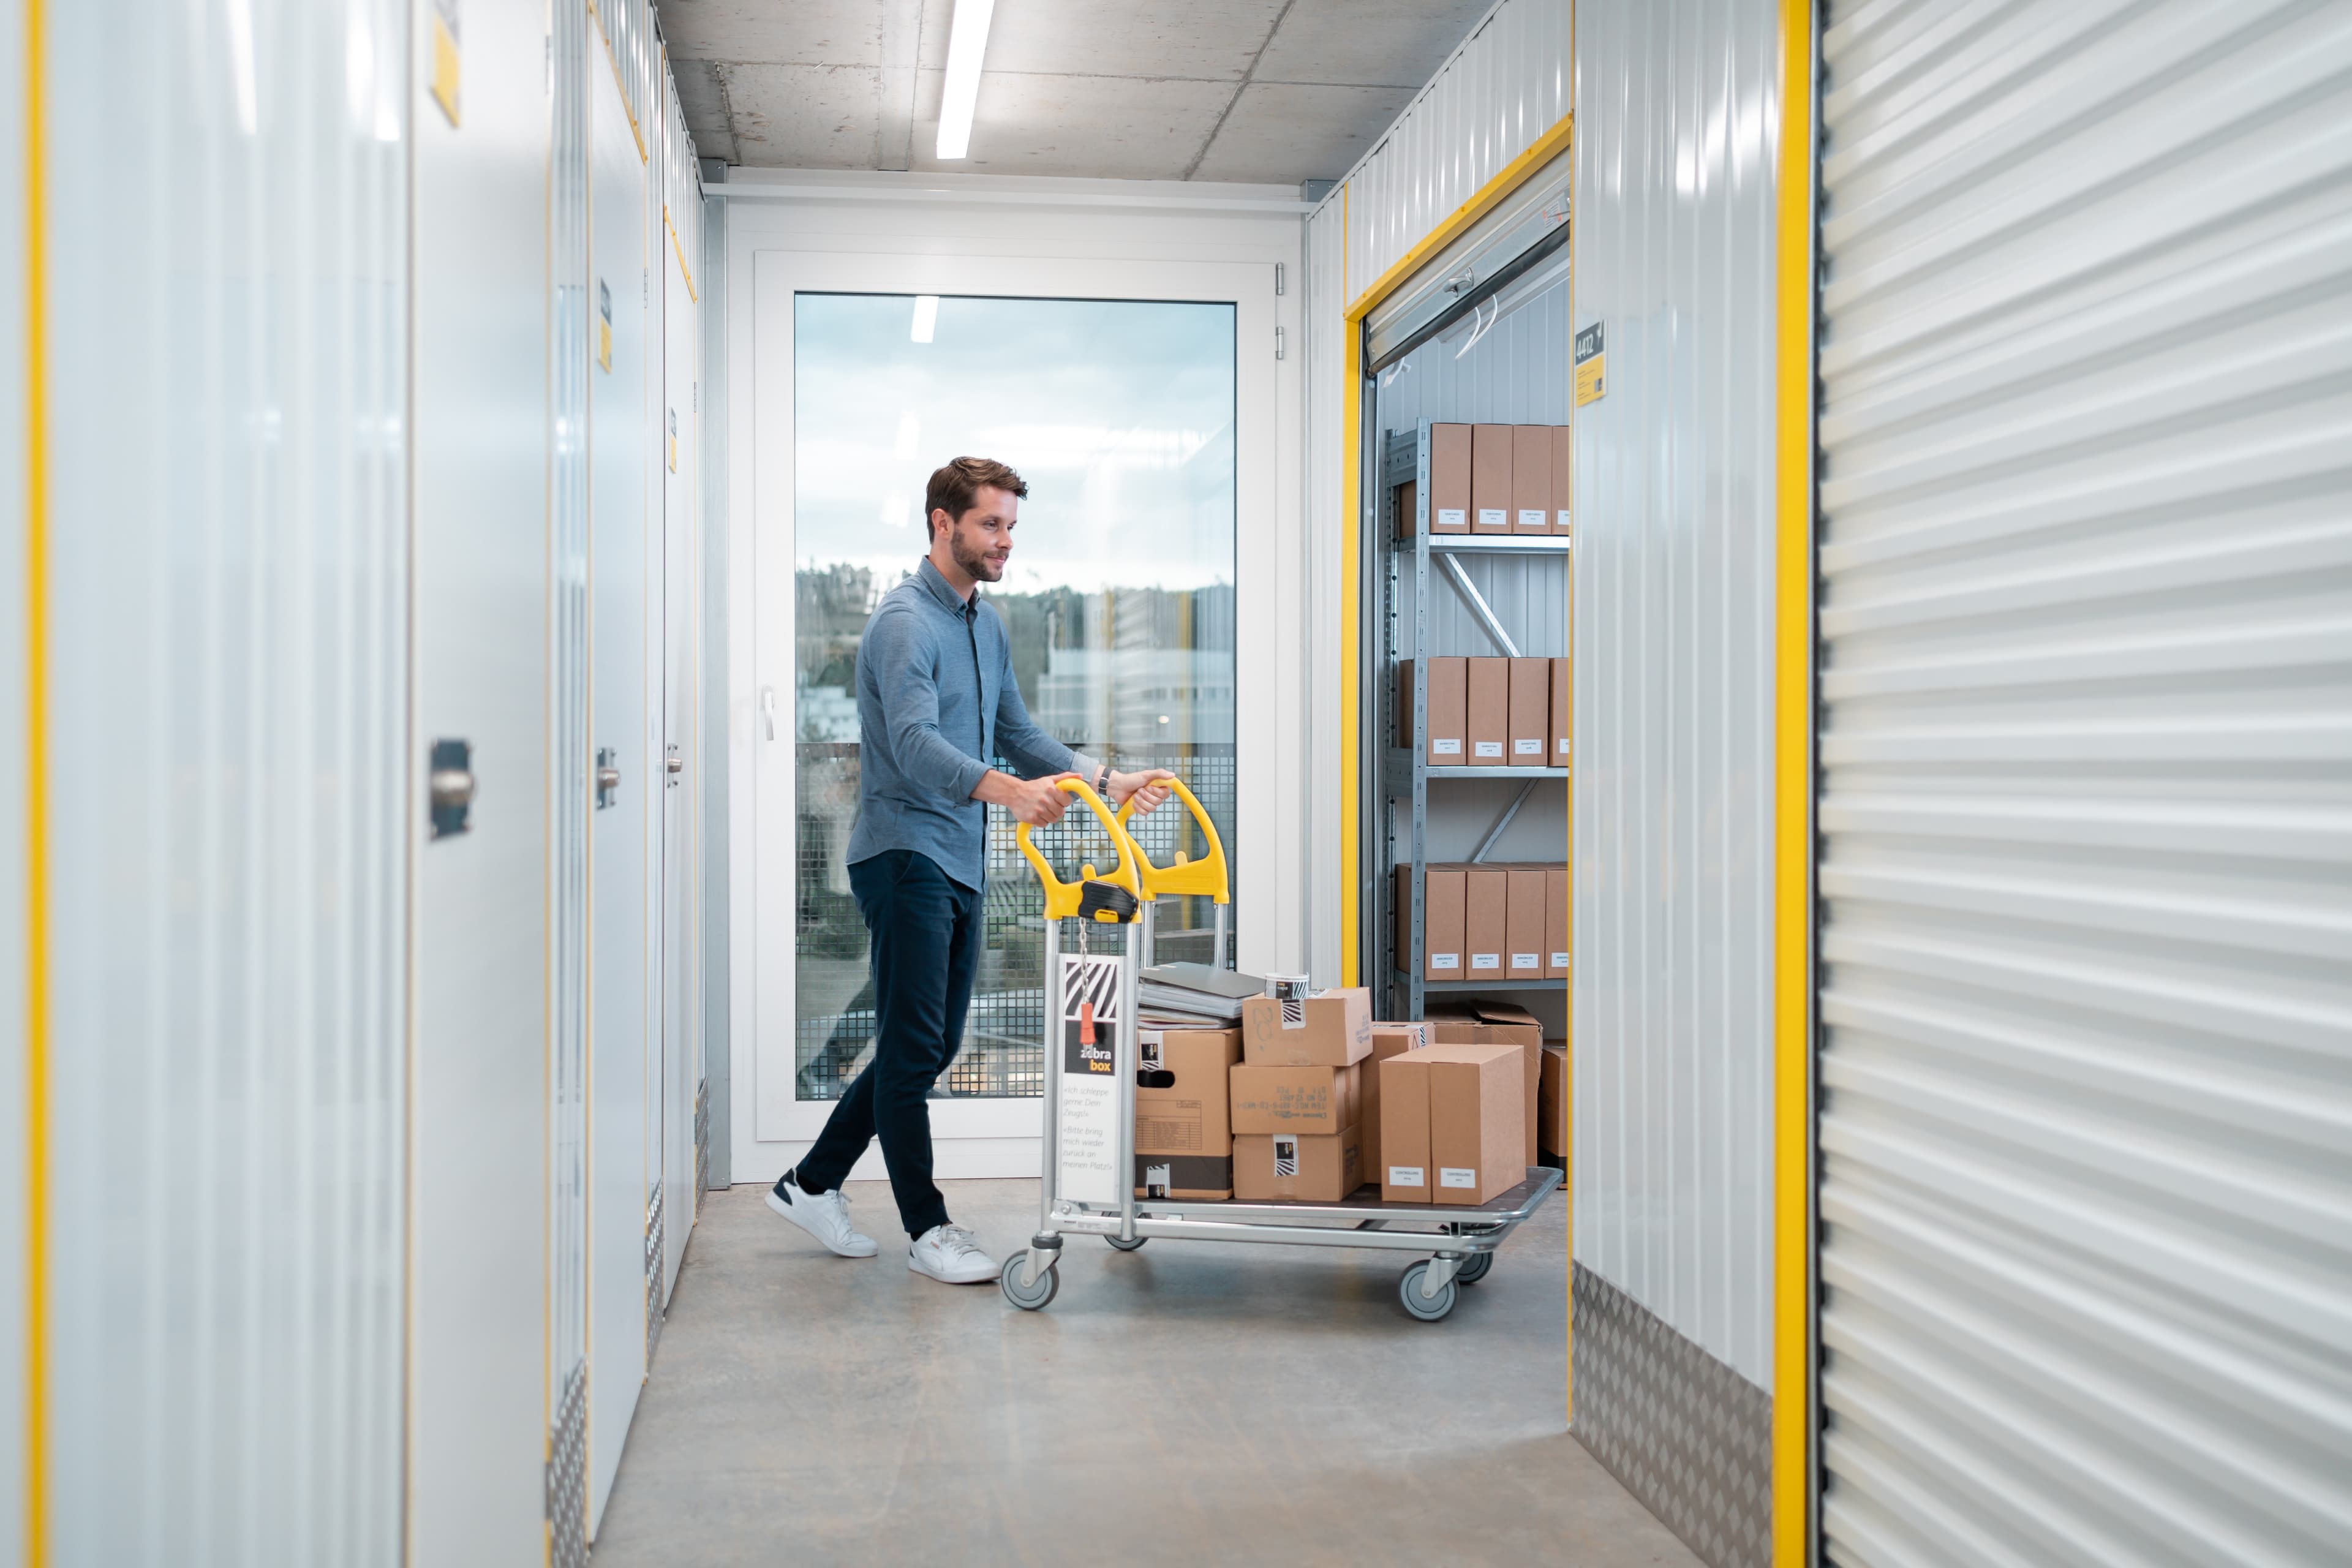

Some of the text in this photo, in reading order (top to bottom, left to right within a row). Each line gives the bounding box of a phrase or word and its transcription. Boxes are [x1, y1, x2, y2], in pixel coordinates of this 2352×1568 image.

[1577, 333, 1594, 360] 4412
[1090, 1058, 1111, 1072] box
[1080, 1087, 1109, 1097] schleppe
[1063, 1098, 1101, 1107] gerne Dein
[1085, 1127, 1103, 1137] bring
